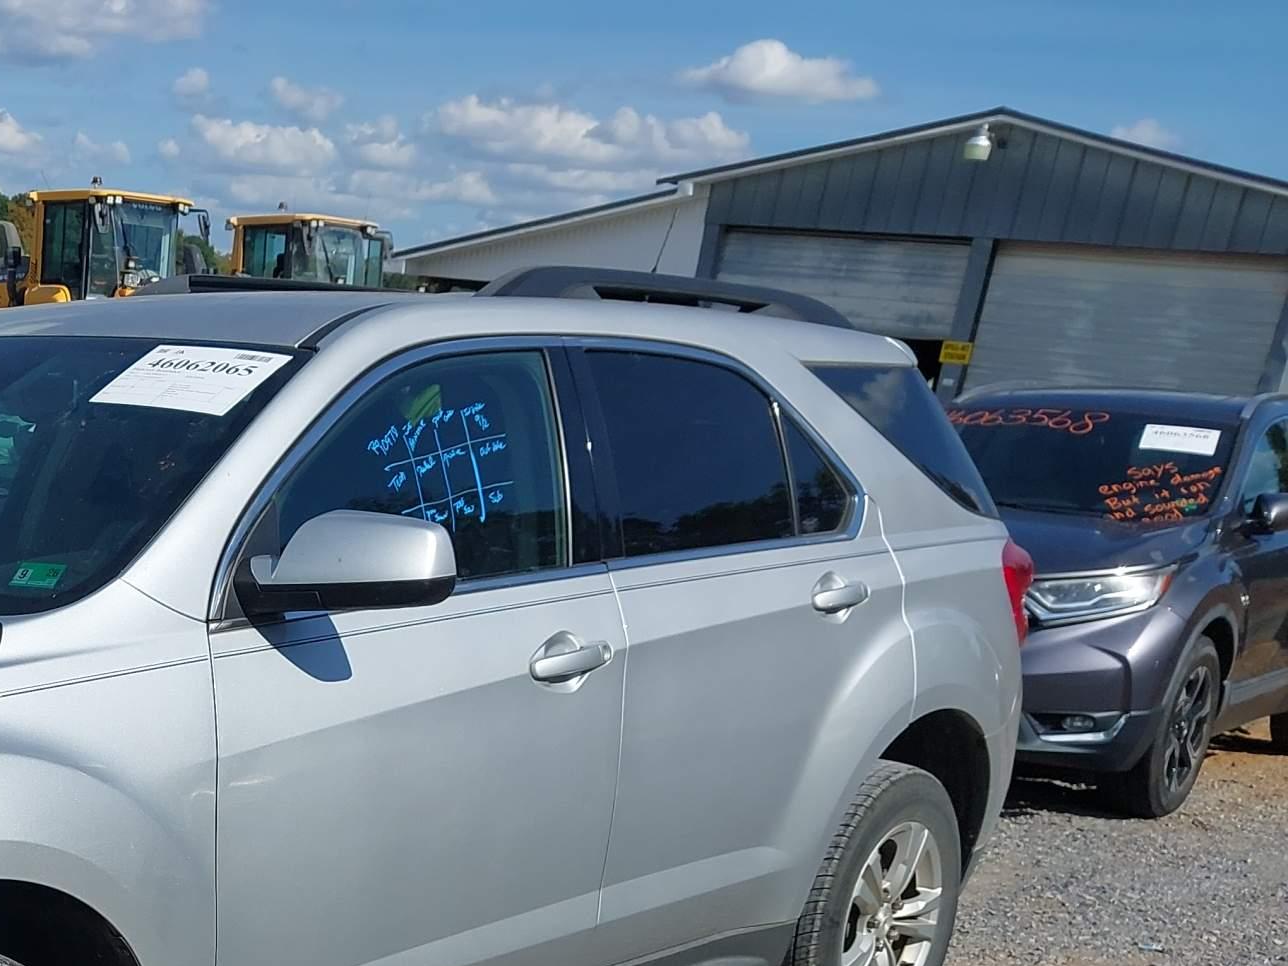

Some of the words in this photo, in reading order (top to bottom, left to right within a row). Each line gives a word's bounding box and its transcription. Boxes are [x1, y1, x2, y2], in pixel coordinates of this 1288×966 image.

[148, 357, 258, 377] 46062065
[1098, 479, 1160, 494] engine
[1105, 495, 1140, 510] But
[1144, 493, 1208, 513] sounded
